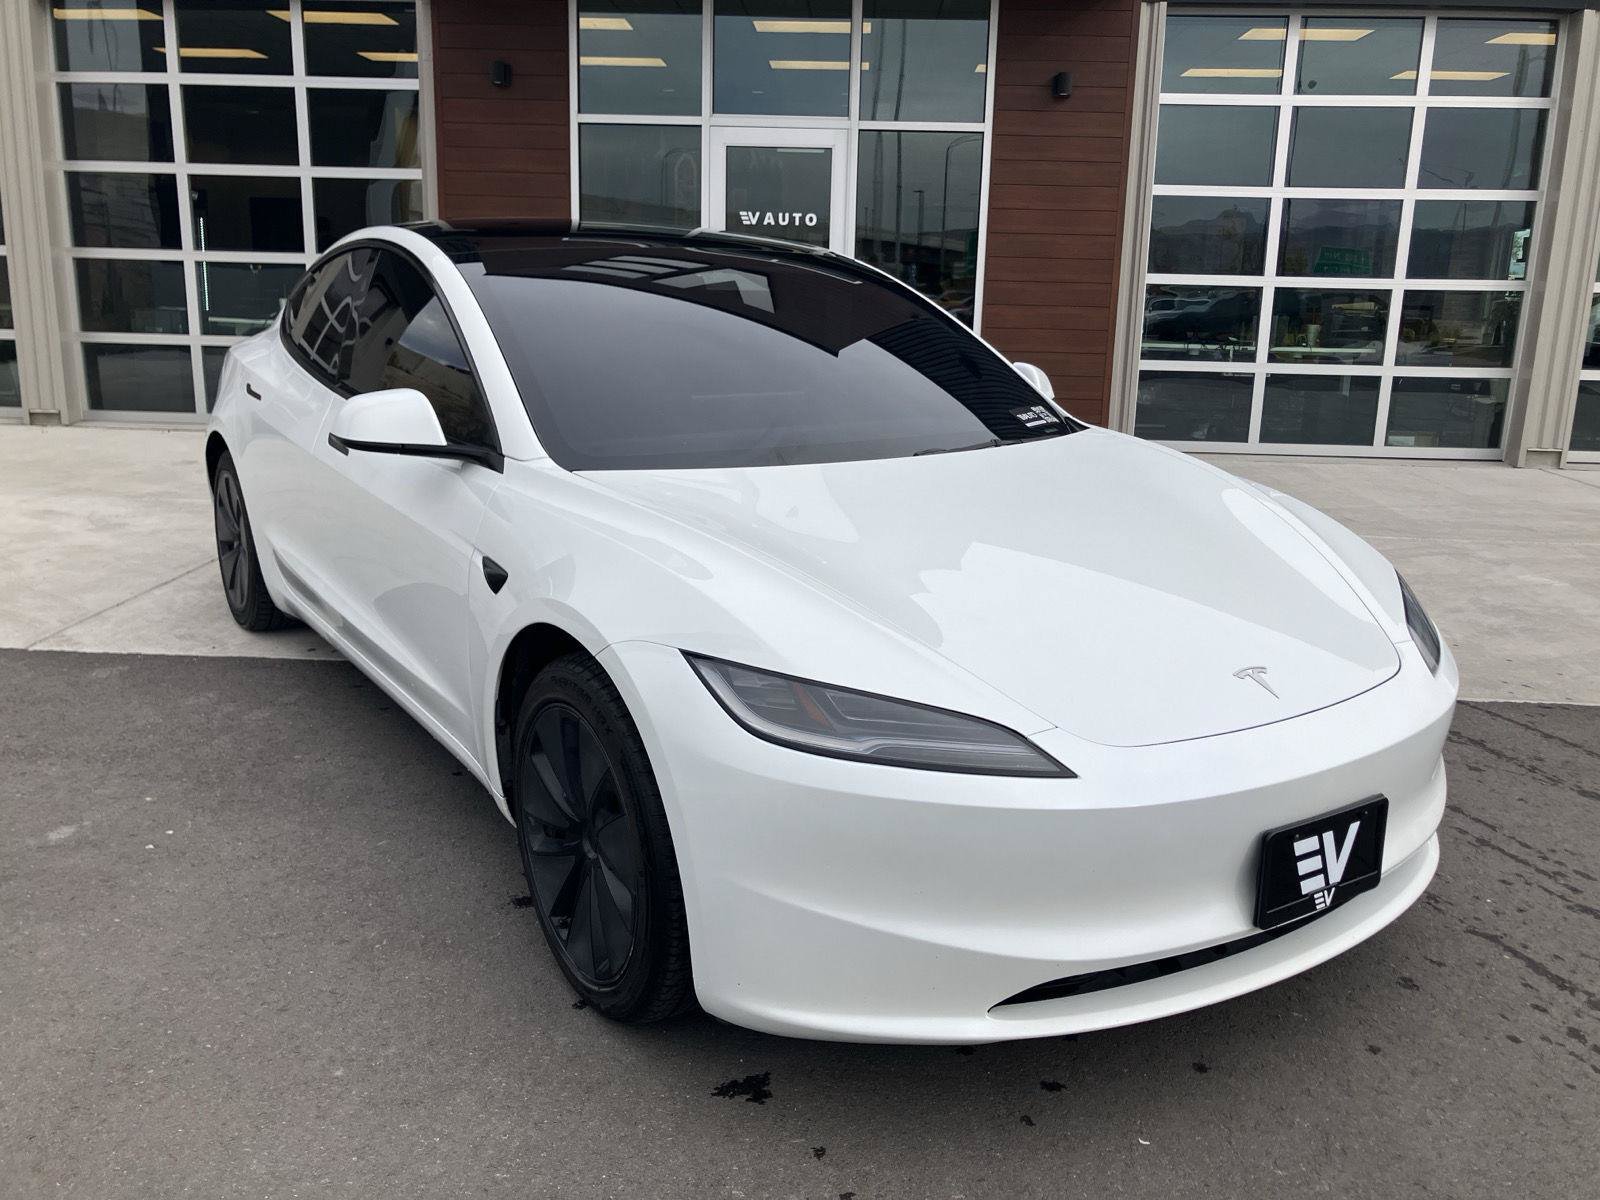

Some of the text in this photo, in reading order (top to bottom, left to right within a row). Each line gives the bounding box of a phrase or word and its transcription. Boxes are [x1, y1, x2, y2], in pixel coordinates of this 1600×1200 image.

[763, 212, 818, 227] AUTO
[1293, 821, 1361, 895] EV
[1314, 886, 1335, 910] EV
